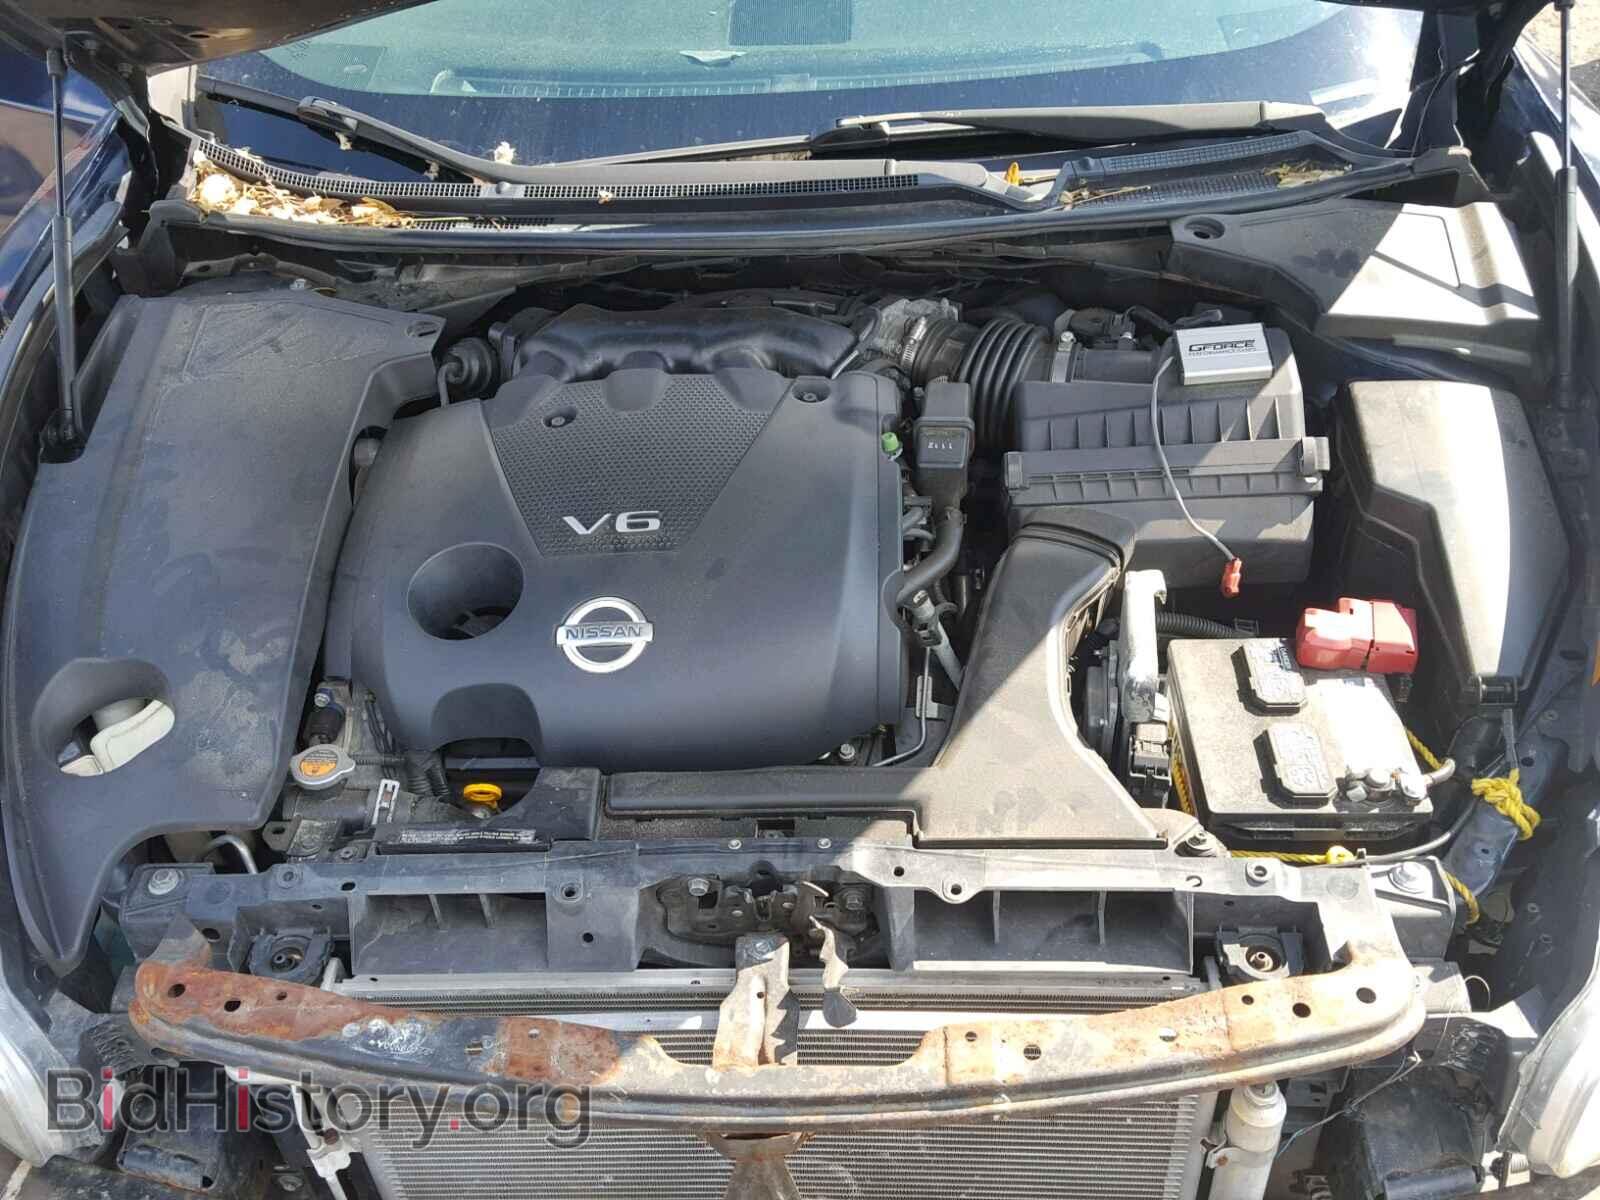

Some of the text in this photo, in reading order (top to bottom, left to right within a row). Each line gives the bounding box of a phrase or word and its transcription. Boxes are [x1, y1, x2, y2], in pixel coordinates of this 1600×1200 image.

[1189, 340, 1255, 352] GFORCE
[563, 511, 660, 534] V6
[566, 626, 642, 640] NISSAN
